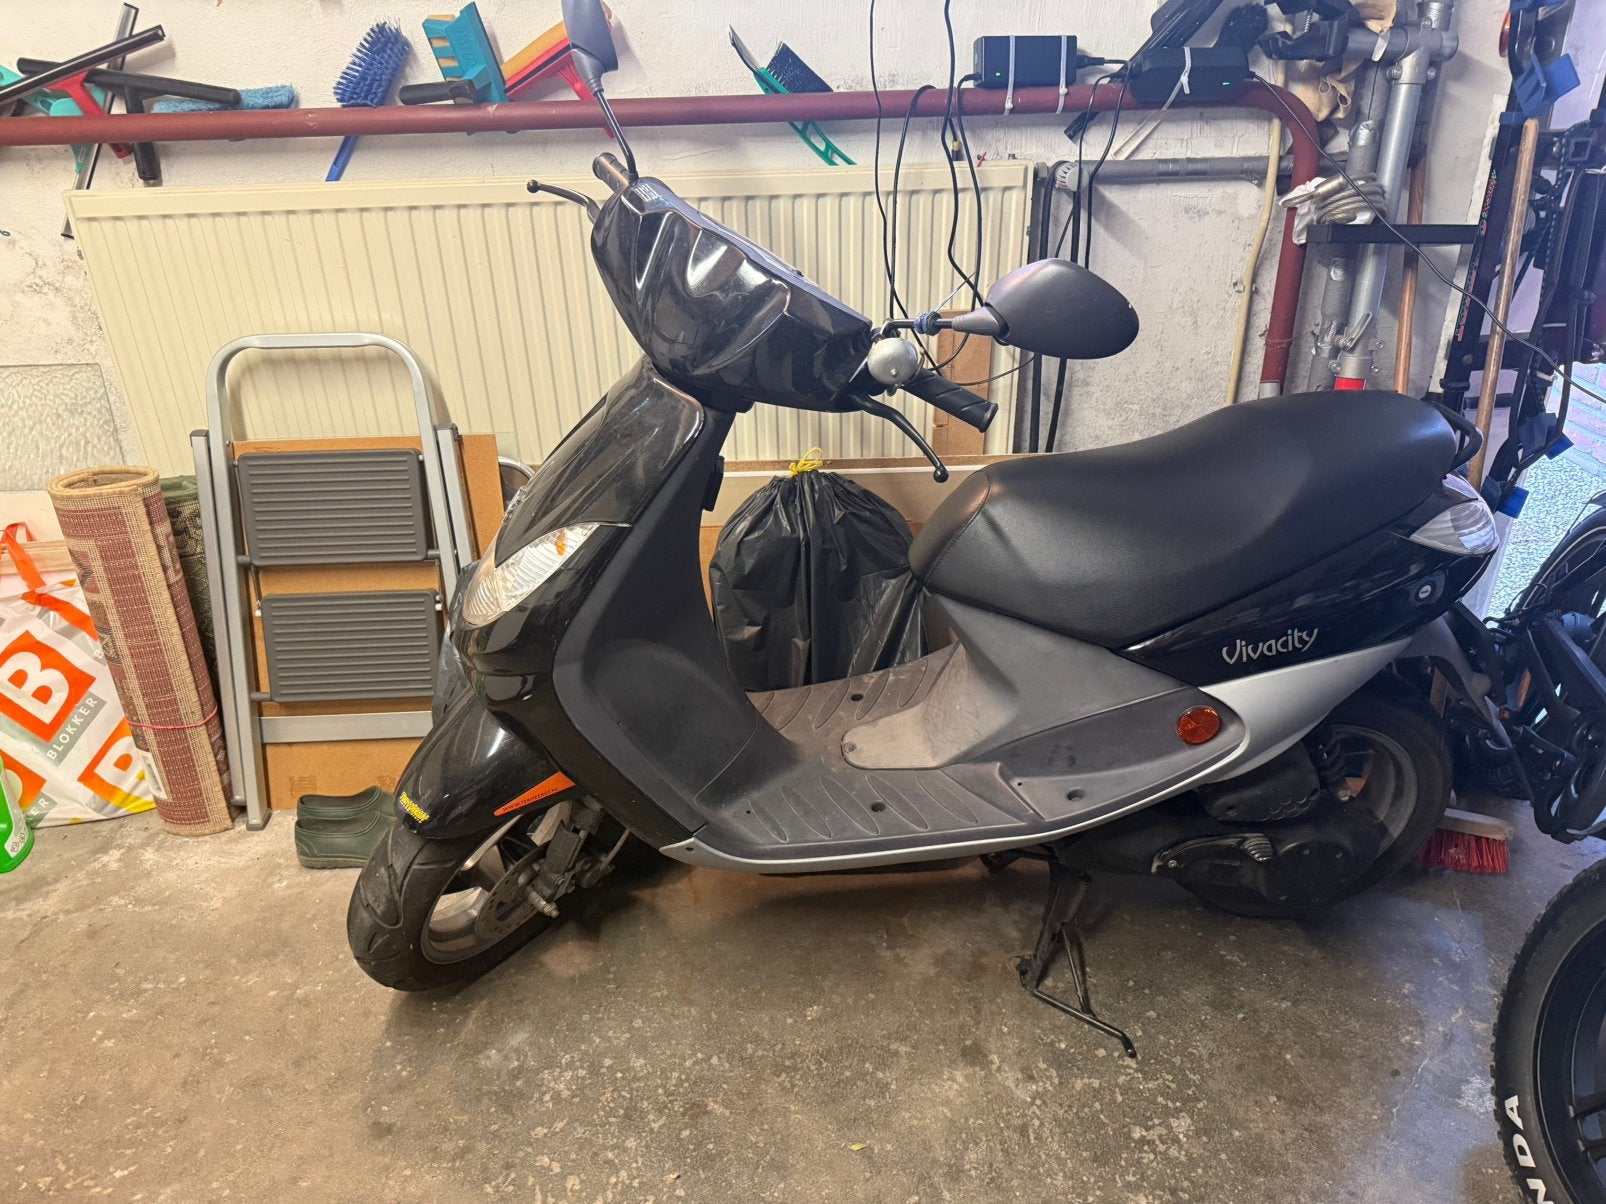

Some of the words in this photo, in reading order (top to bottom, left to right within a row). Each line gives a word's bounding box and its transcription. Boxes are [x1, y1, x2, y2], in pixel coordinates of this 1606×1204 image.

[1222, 628, 1318, 664] Vivacity
[0, 651, 70, 725] B
[46, 697, 98, 760] BLOKKER
